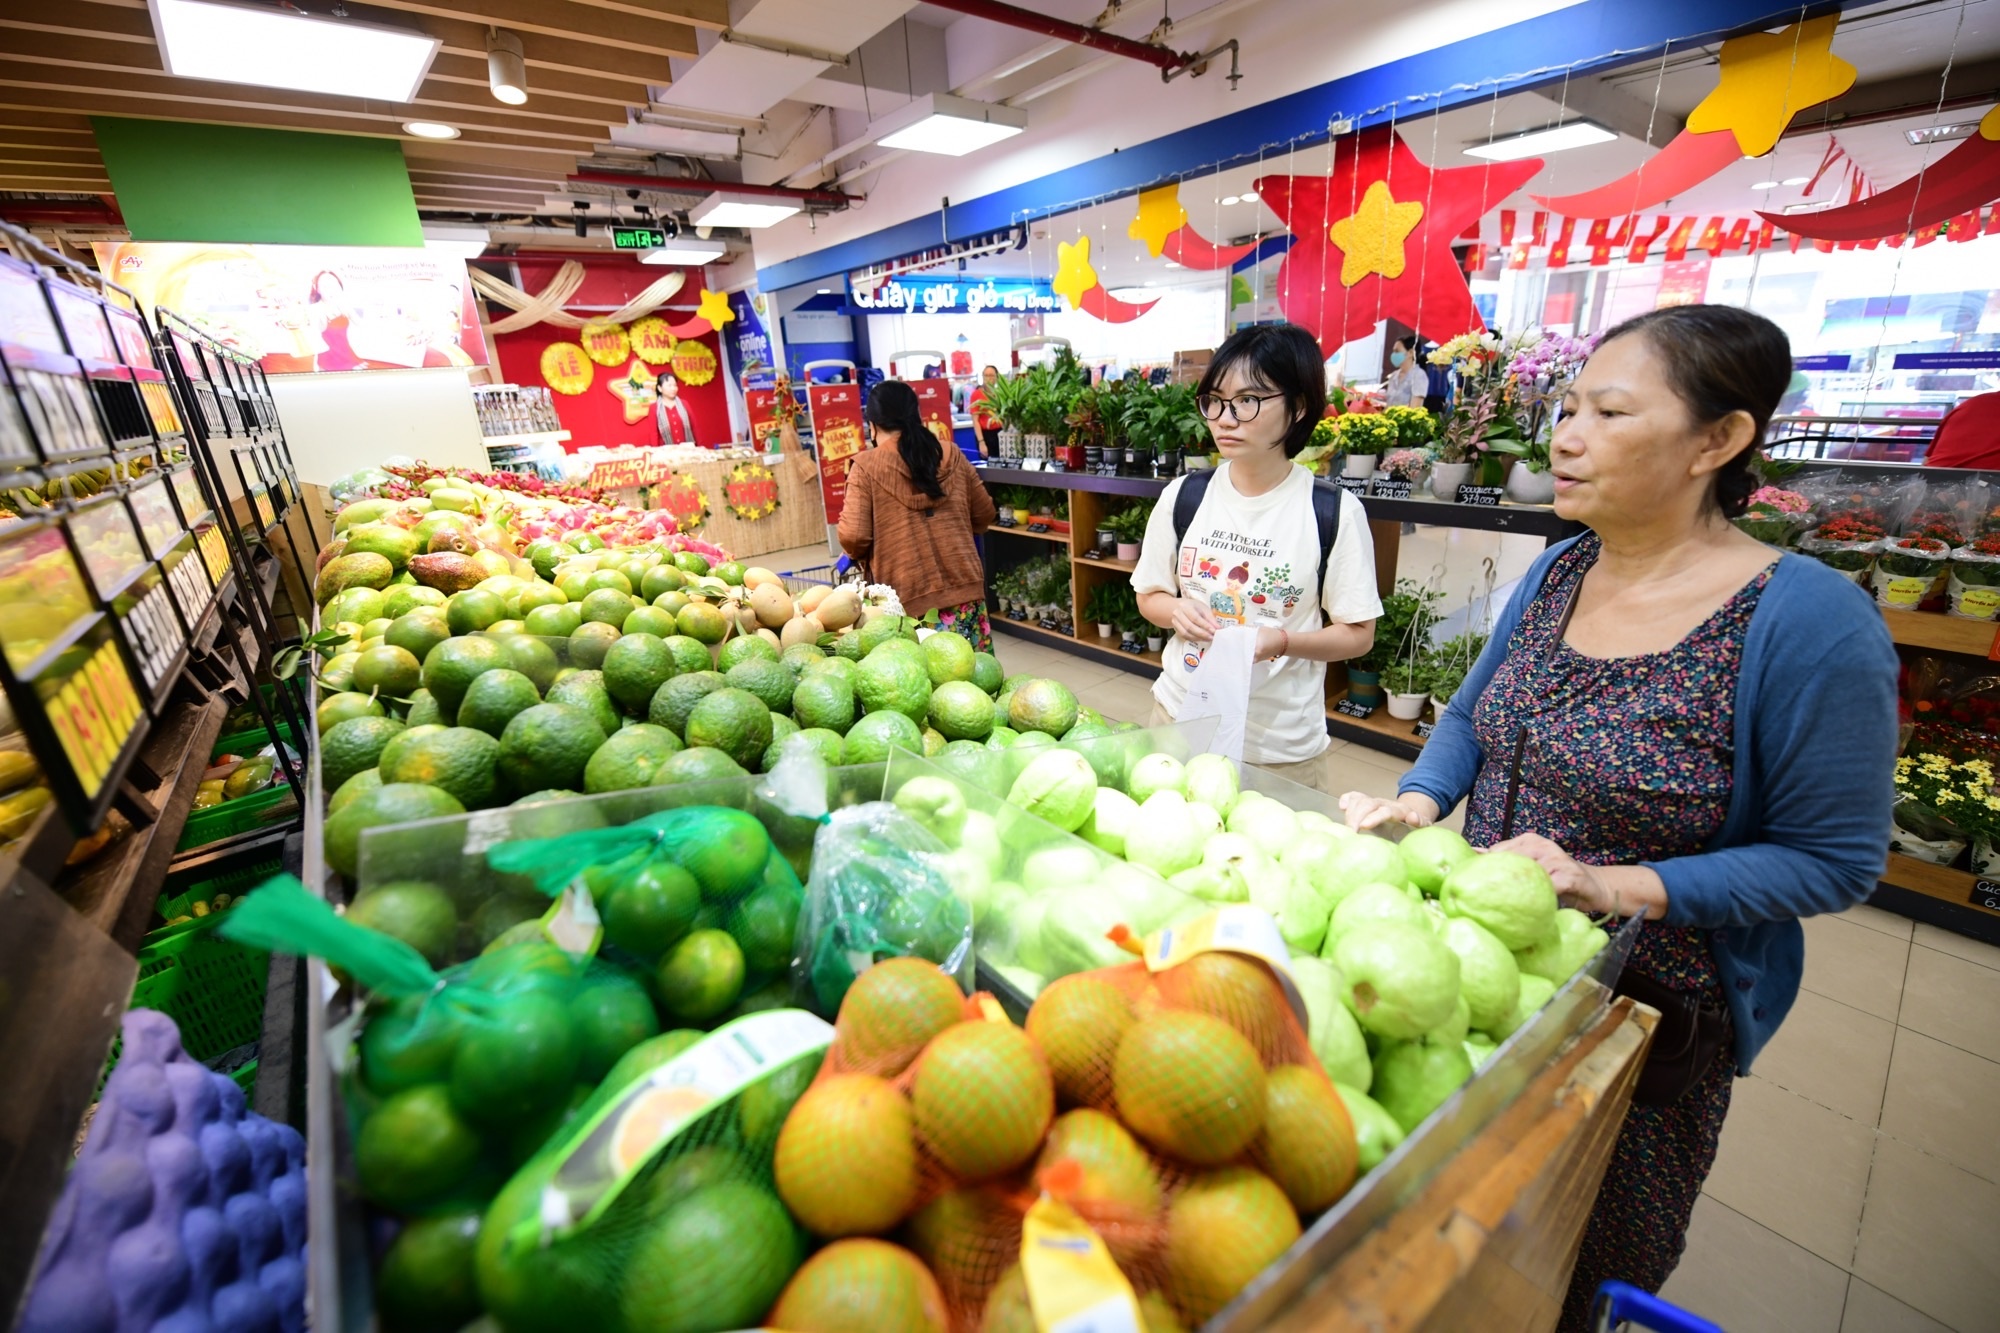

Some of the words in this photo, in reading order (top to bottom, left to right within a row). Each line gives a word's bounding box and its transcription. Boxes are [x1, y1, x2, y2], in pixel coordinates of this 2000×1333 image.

[740, 335, 767, 352] online
[558, 351, 582, 378] LỄ
[637, 452, 667, 484] VIỆT
[1211, 529, 1226, 539] BE
[1227, 532, 1241, 542] AT
[1200, 537, 1229, 550] WITH
[1230, 543, 1277, 558] YOURSELF
